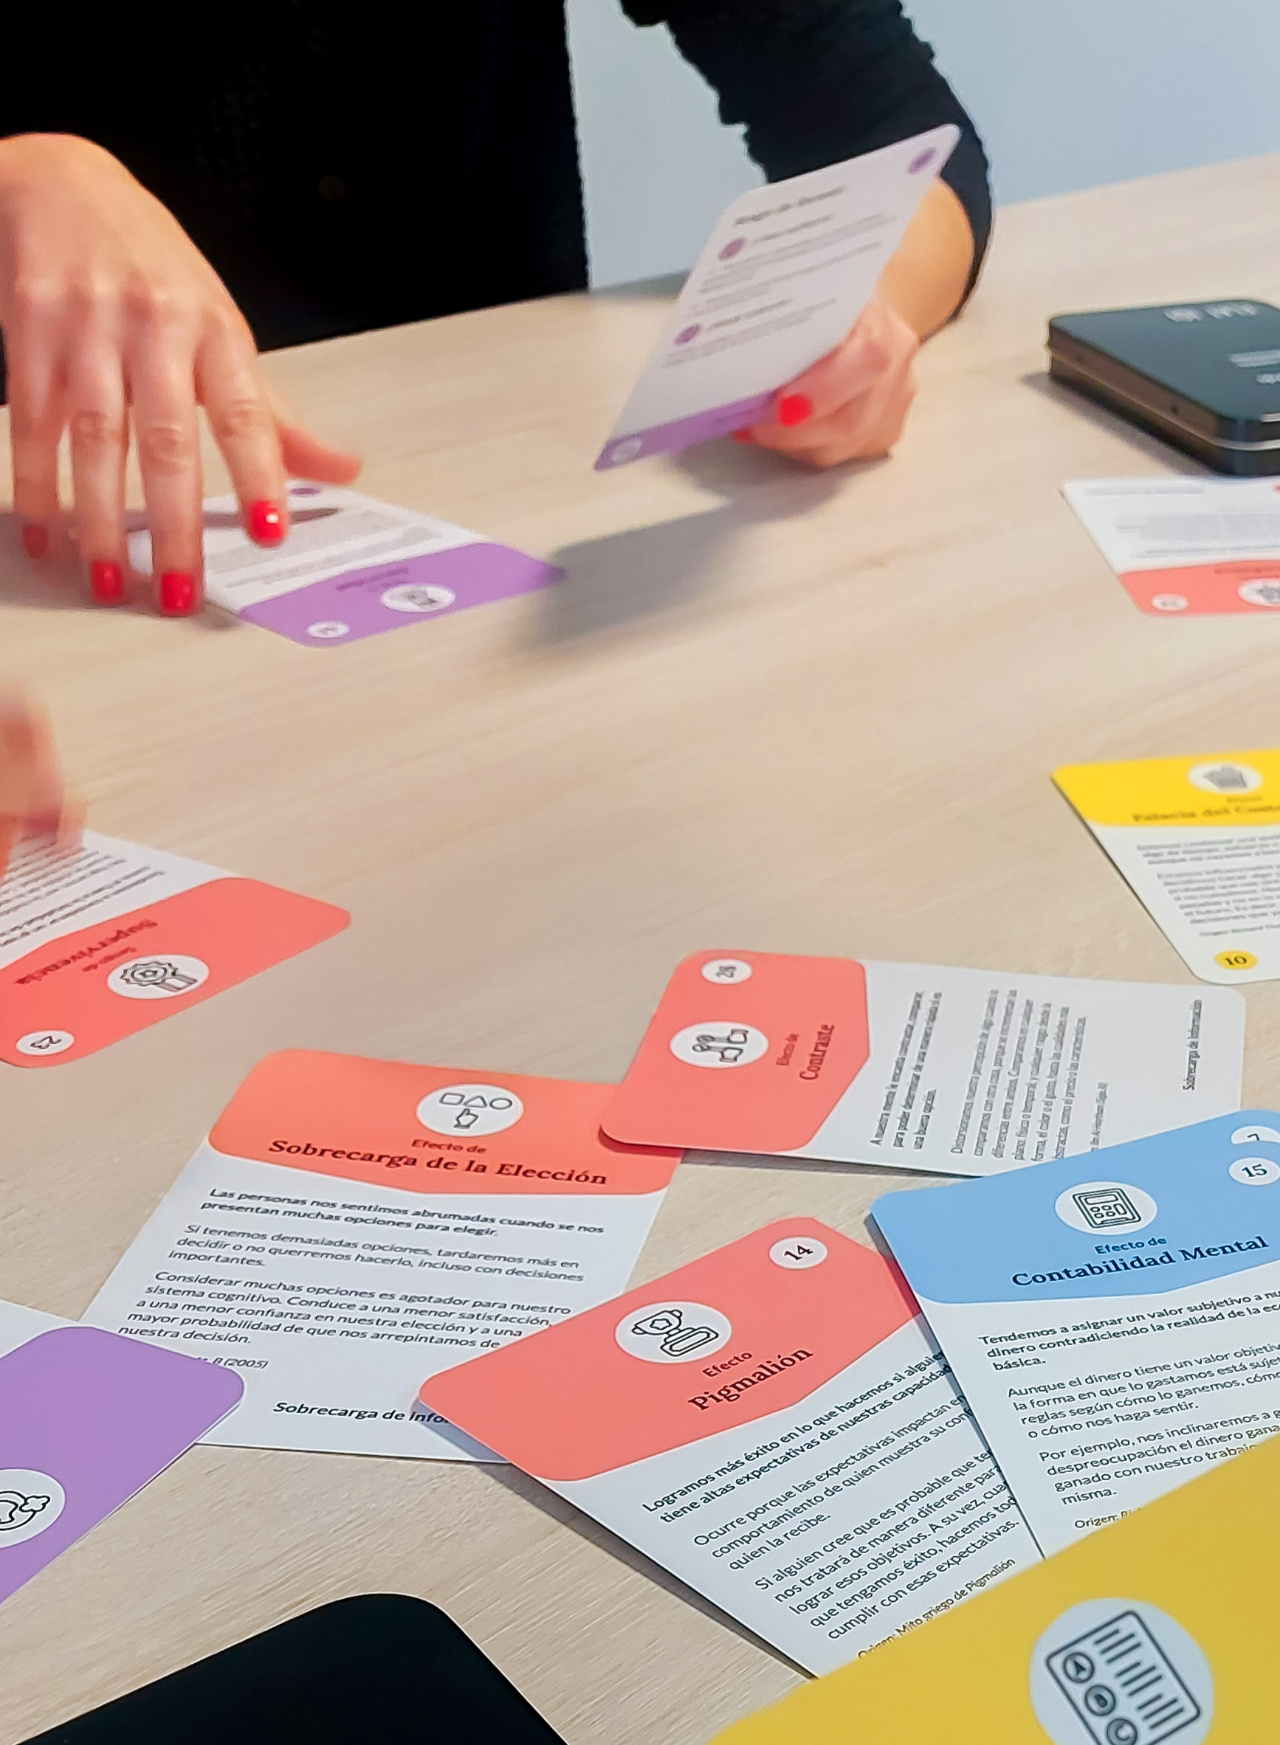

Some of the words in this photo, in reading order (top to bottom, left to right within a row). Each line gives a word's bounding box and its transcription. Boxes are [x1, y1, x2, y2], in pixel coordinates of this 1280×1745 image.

[1224, 955, 1248, 967] 10
[1186, 999, 1202, 1040] Información
[30, 1036, 61, 1050] 23
[798, 1024, 835, 1081] Contraste
[1186, 1040, 1199, 1050] de
[1182, 1050, 1201, 1091] Sobrecarga
[268, 1140, 418, 1168] Sobrecarga
[426, 1156, 459, 1171] de
[464, 1159, 488, 1174] la
[495, 1163, 607, 1185] Elección
[411, 1139, 464, 1152] Efecto
[466, 1145, 487, 1154] de
[1241, 1163, 1268, 1178] 15
[200, 1202, 280, 1216] presentan
[281, 1210, 342, 1222] muchas
[343, 1216, 413, 1228] opciones
[414, 1222, 451, 1232] para
[452, 1225, 498, 1237] elegir.
[209, 1188, 236, 1199] Las
[236, 1193, 308, 1206] personas
[309, 1200, 338, 1209] nos
[340, 1203, 410, 1216] sentimos
[410, 1209, 496, 1224] abrumadas
[498, 1218, 556, 1229] cuando
[577, 1225, 605, 1234] nos
[784, 1244, 814, 1261] 14
[1011, 1250, 1177, 1286] Contabilidad
[1177, 1235, 1270, 1262] Mental
[1094, 1241, 1145, 1255] Efecto
[1147, 1237, 1168, 1247] de
[154, 1271, 243, 1287] Considerar
[243, 1281, 304, 1293] muchas
[306, 1286, 376, 1299] opciones
[378, 1292, 397, 1301] es
[398, 1294, 471, 1306] agotador
[470, 1300, 508, 1310] para
[510, 1303, 572, 1315] nuestro
[117, 1327, 180, 1338] nuestra
[182, 1329, 251, 1344] decisión.
[977, 1328, 1058, 1345] Tendemos
[1059, 1326, 1070, 1334] a
[1071, 1317, 1123, 1332] asignar
[1125, 1314, 1147, 1323] un
[1146, 1307, 1184, 1319] valor
[1186, 1296, 1252, 1313] subjetivo
[986, 1345, 1037, 1358] dinero
[1038, 1326, 1150, 1350] contradiciendo
[1149, 1323, 1165, 1332] la
[1166, 1311, 1226, 1330] realidad
[1227, 1309, 1246, 1319] de
[1245, 1306, 1261, 1316] la
[223, 1358, 269, 1370] (2005)
[687, 1349, 814, 1411] Pigmalión
[701, 1352, 753, 1378] Efecto
[992, 1357, 1047, 1371] básica.
[1008, 1382, 1067, 1399] Aunque
[1068, 1376, 1083, 1388] el
[1084, 1370, 1133, 1385] dinero
[1133, 1364, 1172, 1376] tiene
[1173, 1360, 1194, 1369] un
[1193, 1352, 1231, 1365] valor
[272, 1402, 379, 1420] Sobrecarga
[381, 1409, 406, 1421] de
[408, 1410, 446, 1424] Info
[641, 1474, 716, 1513] Logramos
[713, 1459, 746, 1477] más
[743, 1441, 781, 1462] éxito
[779, 1432, 800, 1444] en
[794, 1424, 813, 1435] lo
[812, 1410, 840, 1426] que
[834, 1380, 895, 1413] hacemos
[892, 1372, 907, 1384] si
[659, 1501, 701, 1523] tiene
[699, 1483, 736, 1504] altas
[735, 1438, 821, 1486] expectativas
[819, 1429, 839, 1441] de
[836, 1399, 894, 1432] nuestras
[693, 1517, 748, 1546] Ocurre
[745, 1490, 797, 1522] porque
[791, 1479, 817, 1493] las
[814, 1435, 896, 1482] expectativas
[890, 1404, 952, 1439] impactan
[1061, 1488, 1117, 1505] misma.
[729, 1545, 771, 1570] quien
[765, 1538, 785, 1549] la
[782, 1514, 832, 1541] recibe.
[828, 1604, 880, 1640] cumplir
[880, 1589, 908, 1607] con
[905, 1570, 938, 1592] esas
[935, 1520, 1020, 1573] expectativas.
[894, 1618, 924, 1637] Mito
[953, 1589, 969, 1601] de
[964, 1558, 1016, 1592] Pigmalión
